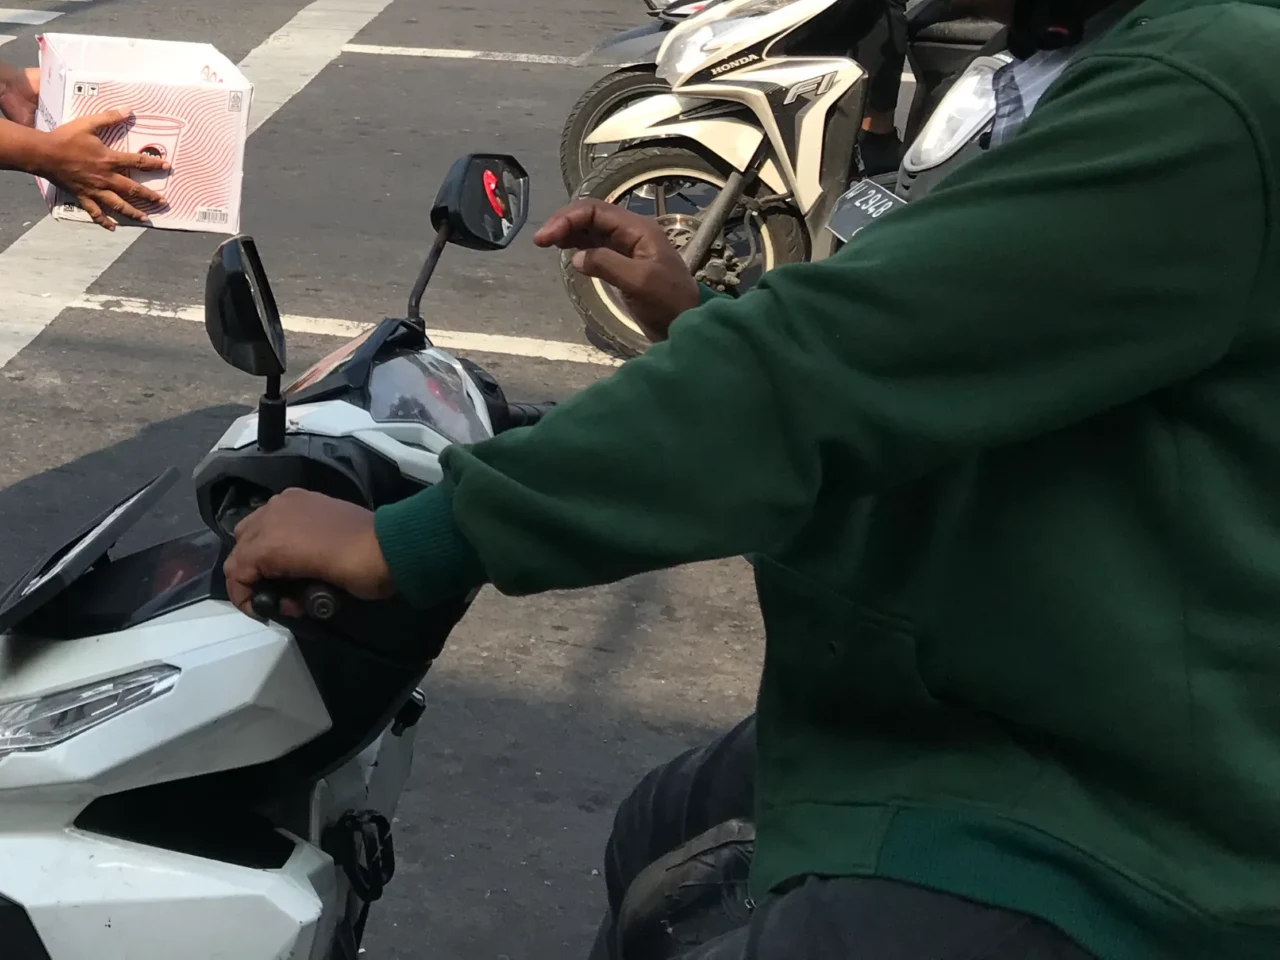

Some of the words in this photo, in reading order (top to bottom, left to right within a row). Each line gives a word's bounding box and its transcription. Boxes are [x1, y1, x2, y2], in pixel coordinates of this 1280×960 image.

[710, 54, 760, 76] HONDA
[783, 71, 839, 105] FI
[854, 189, 894, 218] 2948
